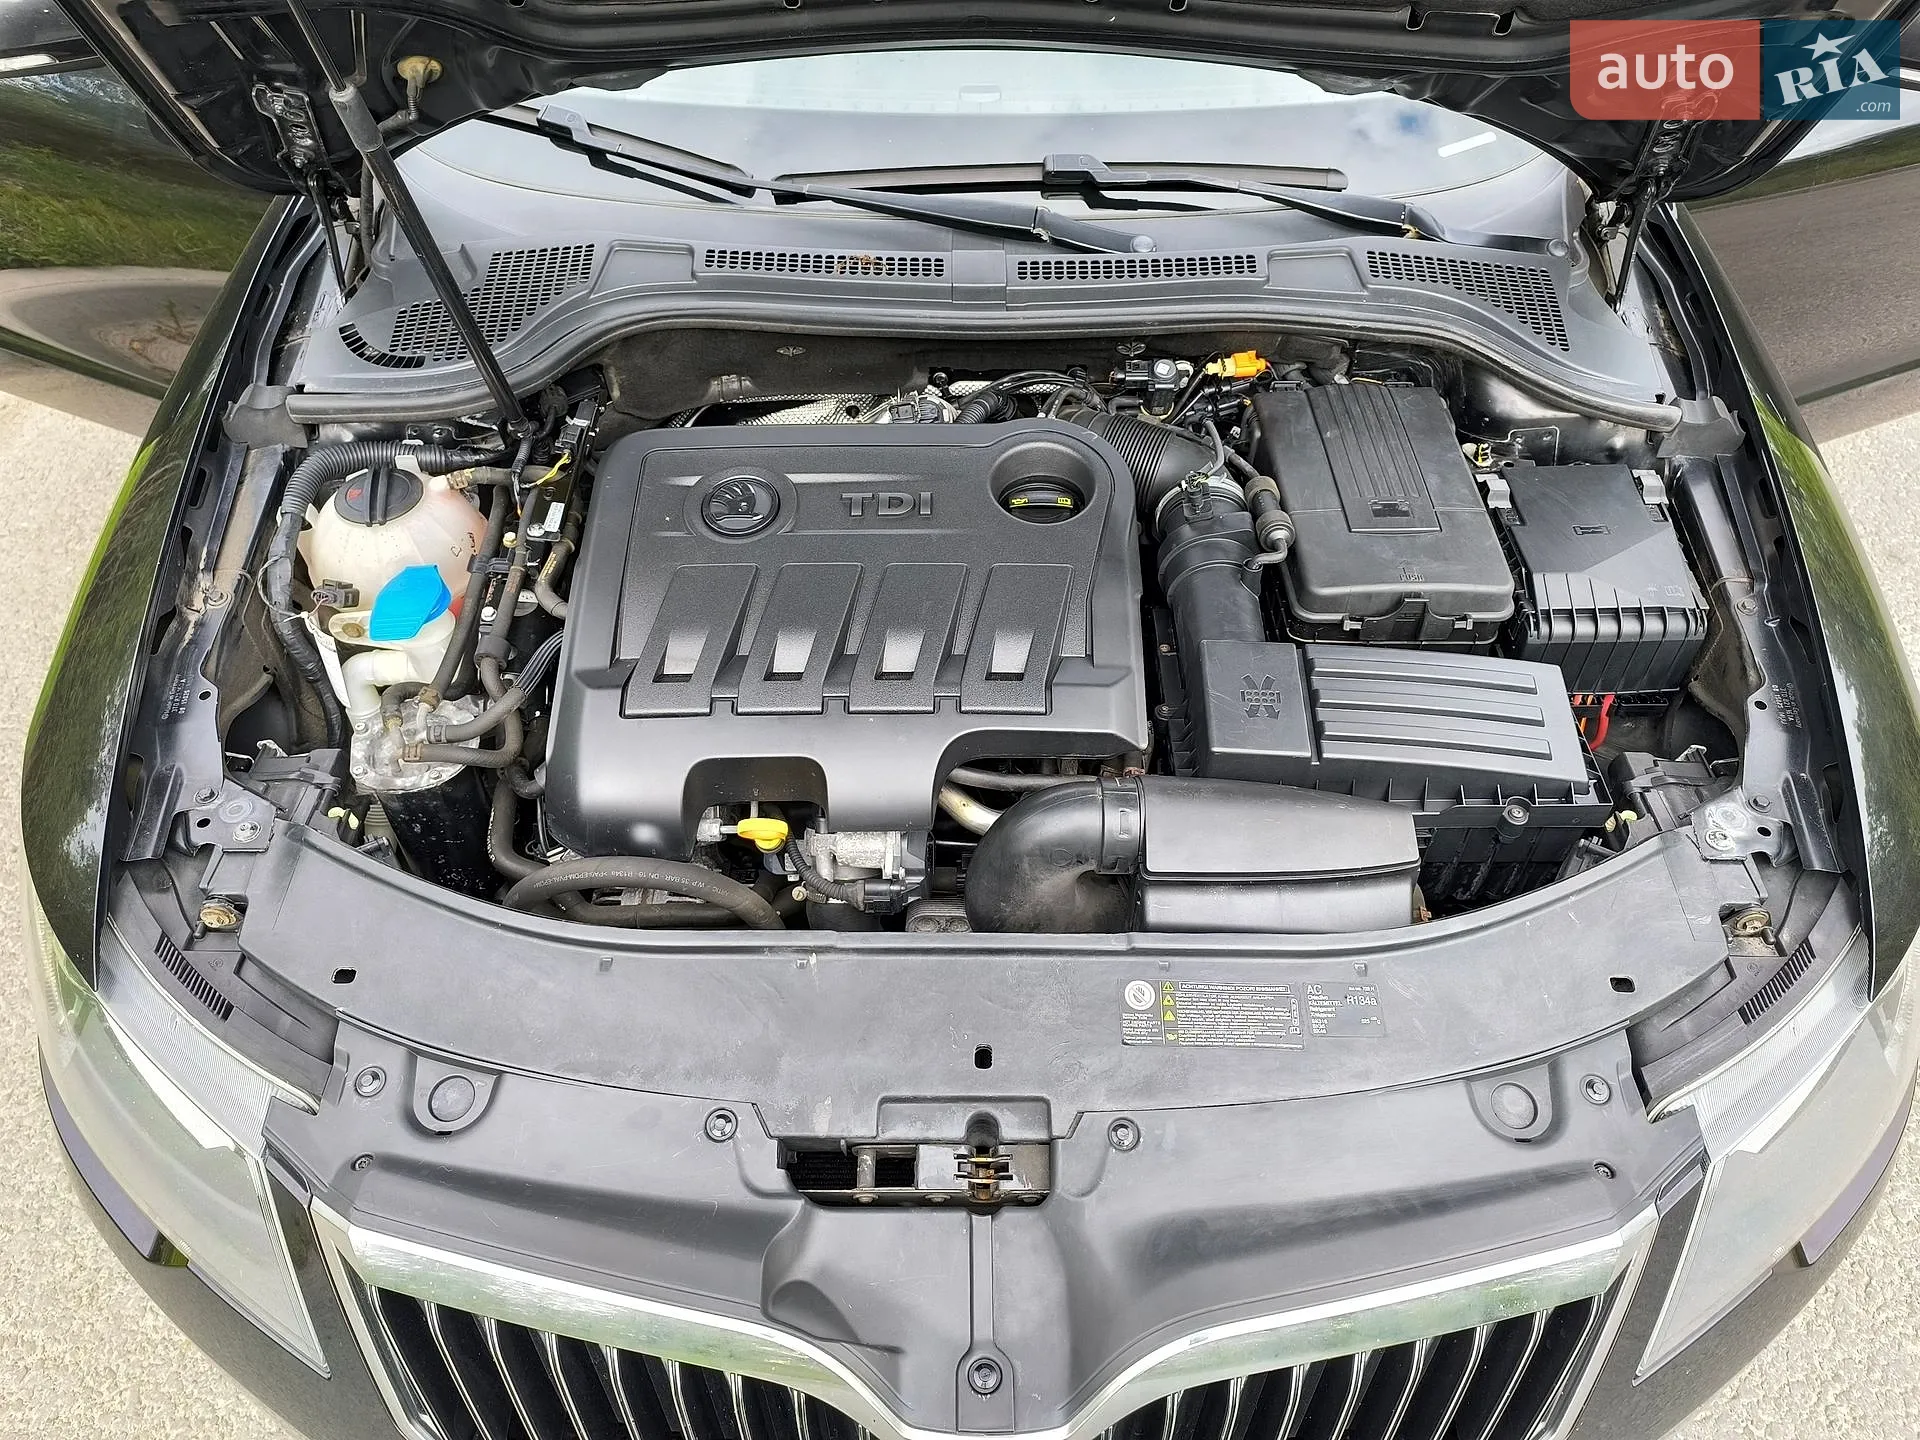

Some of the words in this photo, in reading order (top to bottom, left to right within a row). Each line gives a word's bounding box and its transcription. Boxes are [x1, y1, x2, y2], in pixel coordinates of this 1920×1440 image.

[841, 492, 932, 517] TDI
[665, 875, 681, 884] BAR
[1307, 984, 1322, 995] AC
[1347, 995, 1378, 1006] R134a
